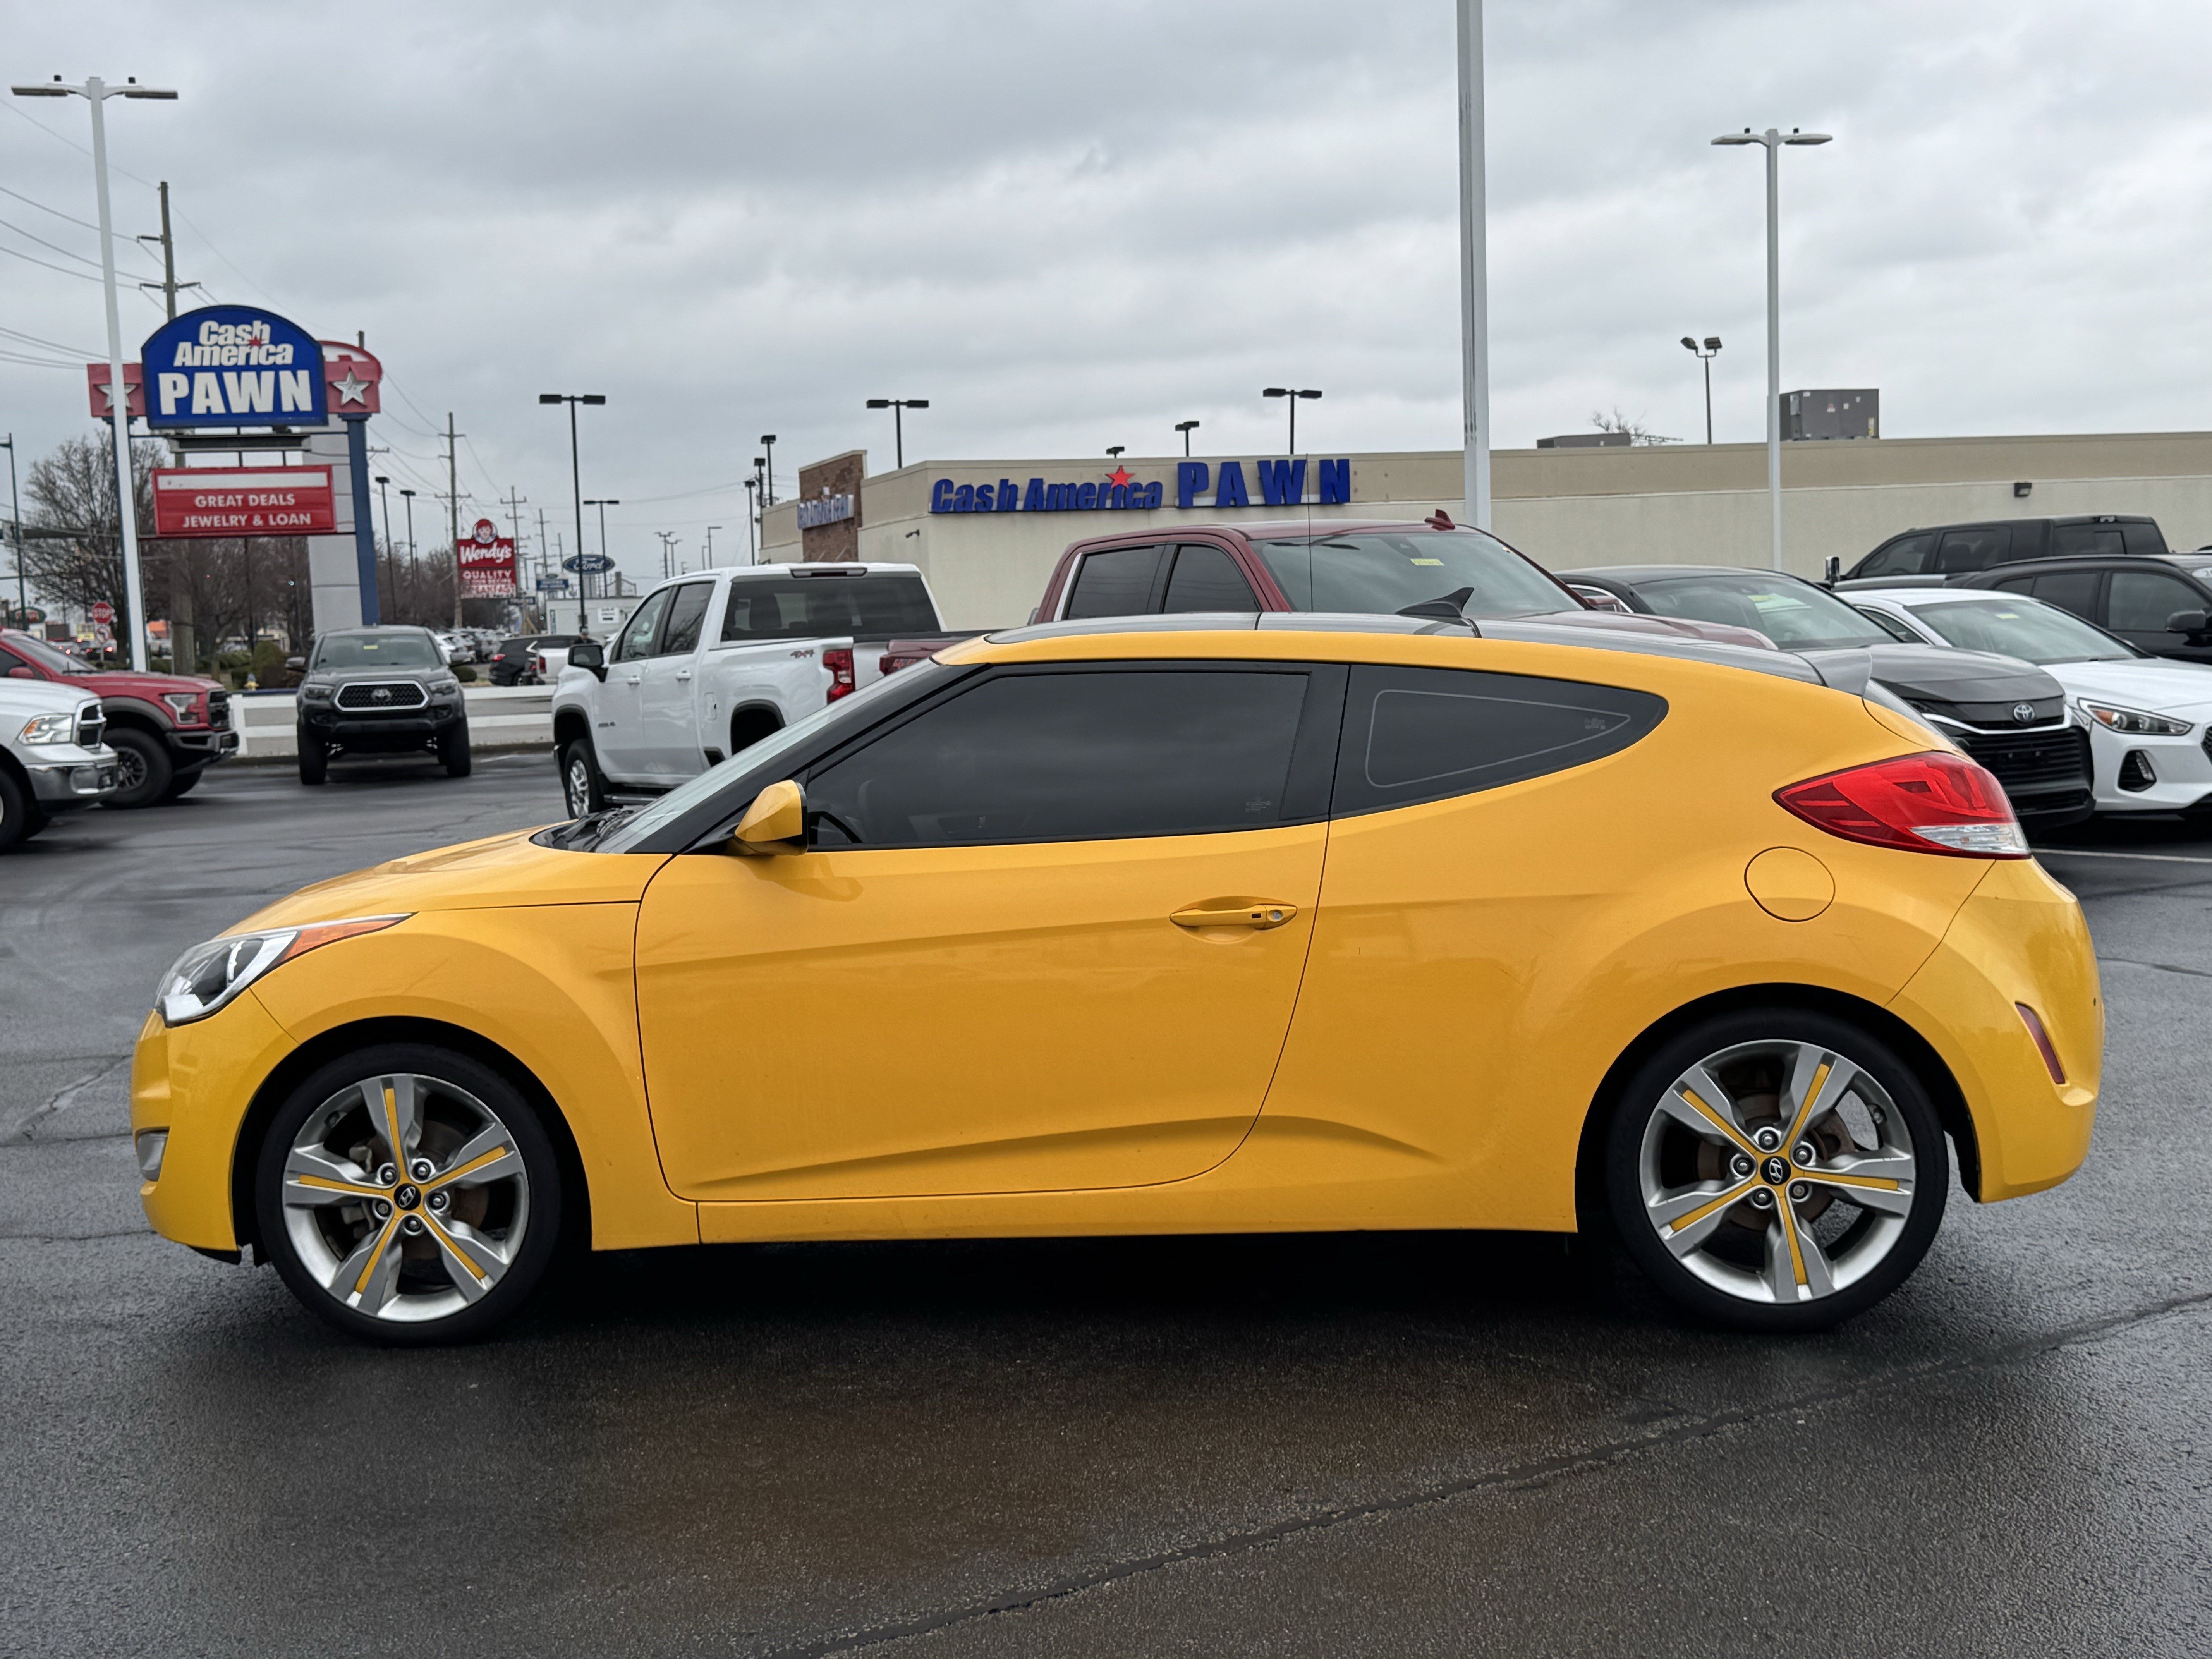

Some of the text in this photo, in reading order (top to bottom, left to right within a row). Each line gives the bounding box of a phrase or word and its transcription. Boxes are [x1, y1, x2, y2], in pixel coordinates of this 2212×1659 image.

[199, 320, 271, 345] Cash
[173, 341, 294, 367] America
[158, 370, 313, 415] PAWN
[931, 459, 1351, 513] Cash America PAWN
[195, 493, 295, 508] GREAT DEALS
[182, 512, 312, 528] JEWELRY & LOAN
[460, 541, 512, 565] Wendy's
[573, 557, 605, 570] Ford
[462, 569, 512, 580] QUALITY
[93, 608, 111, 618] STOP
